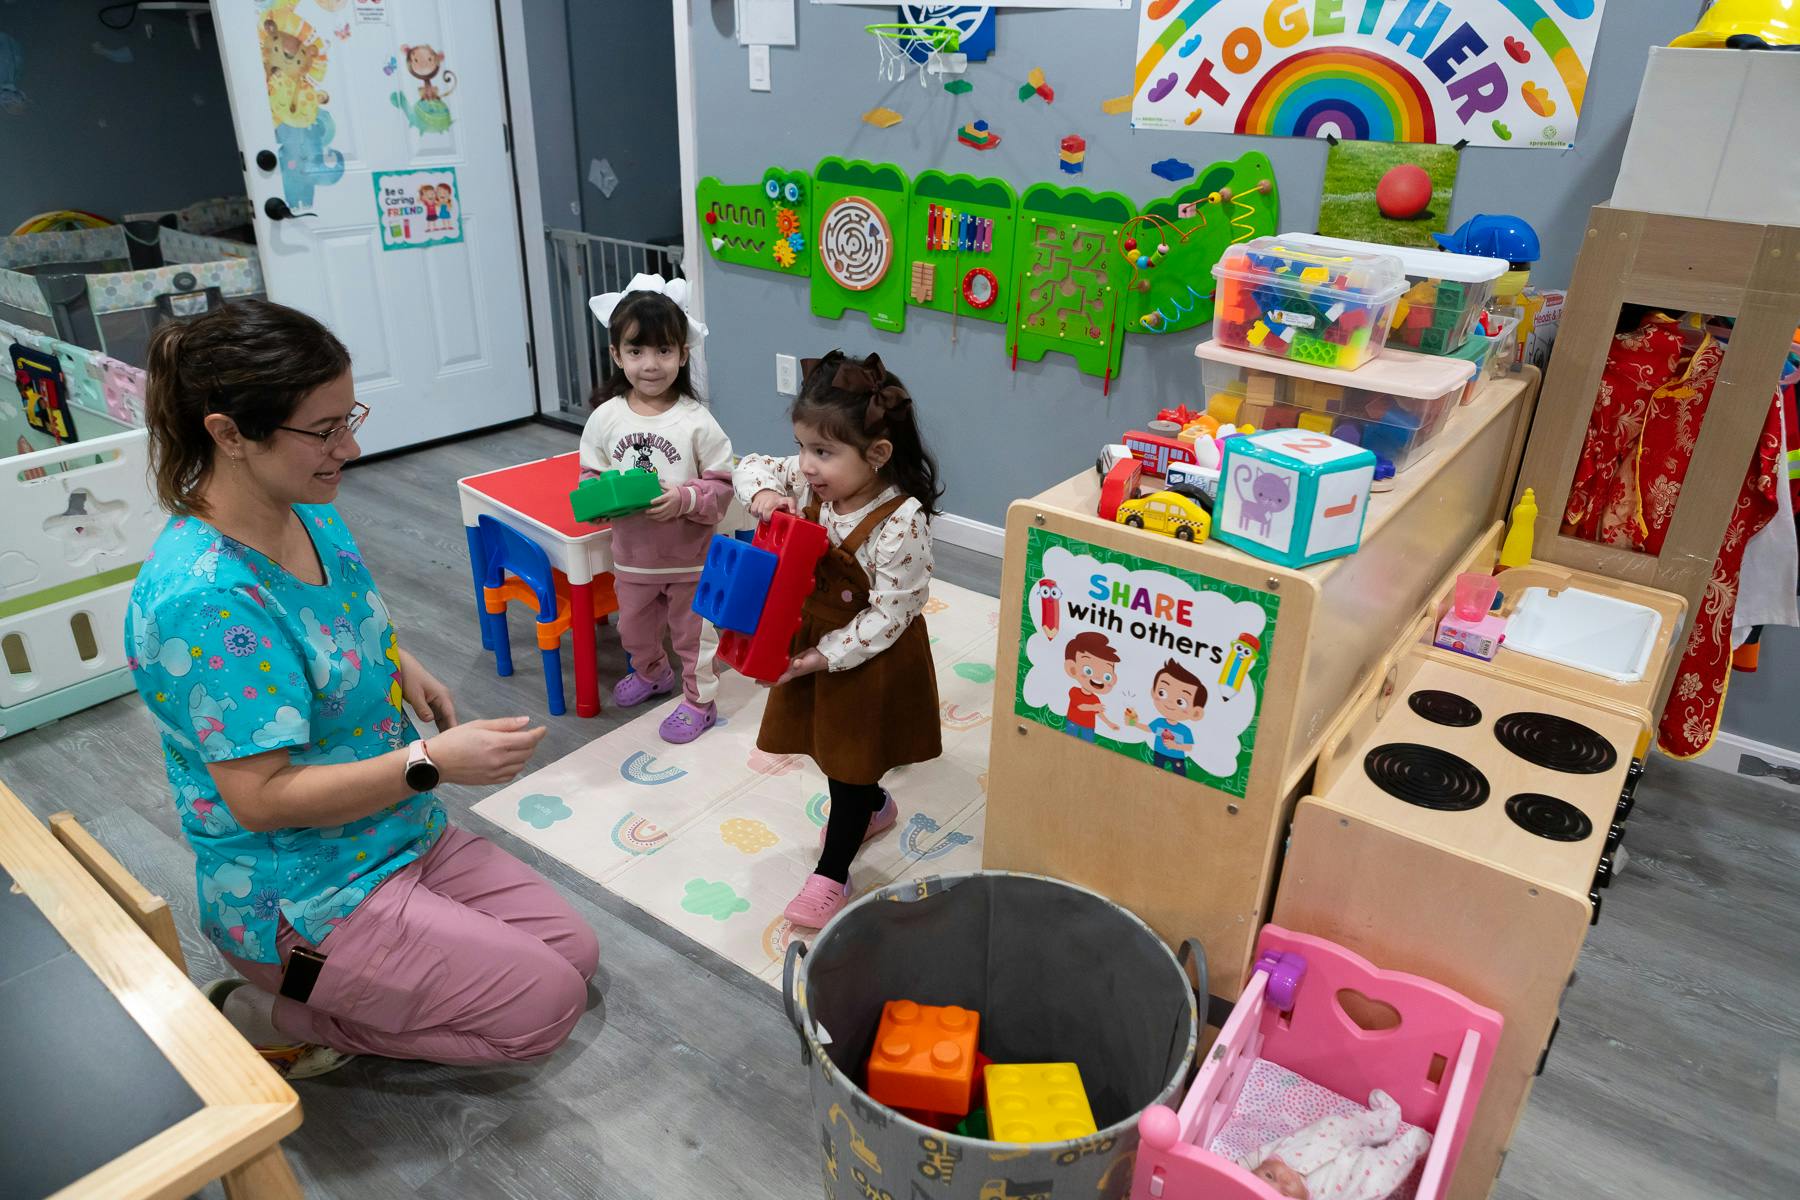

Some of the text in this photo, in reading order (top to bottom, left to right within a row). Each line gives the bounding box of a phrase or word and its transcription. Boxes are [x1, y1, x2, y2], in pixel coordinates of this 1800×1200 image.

[385, 188, 396, 196] Be
[385, 197, 415, 206] Caring
[387, 206, 424, 217] FRIEND
[1060, 230, 1065, 240] 8
[1086, 243, 1092, 251] 9
[1101, 261, 1106, 269] 6
[1042, 292, 1048, 300] 4
[1097, 290, 1103, 298] 5
[1040, 318, 1045, 326] 3
[1061, 322, 1066, 331] 2
[612, 432, 682, 465] MINNIE MOUSE
[1282, 438, 1332, 454] 2
[1088, 574, 1193, 628] SHARE
[1067, 601, 1223, 664] with others
